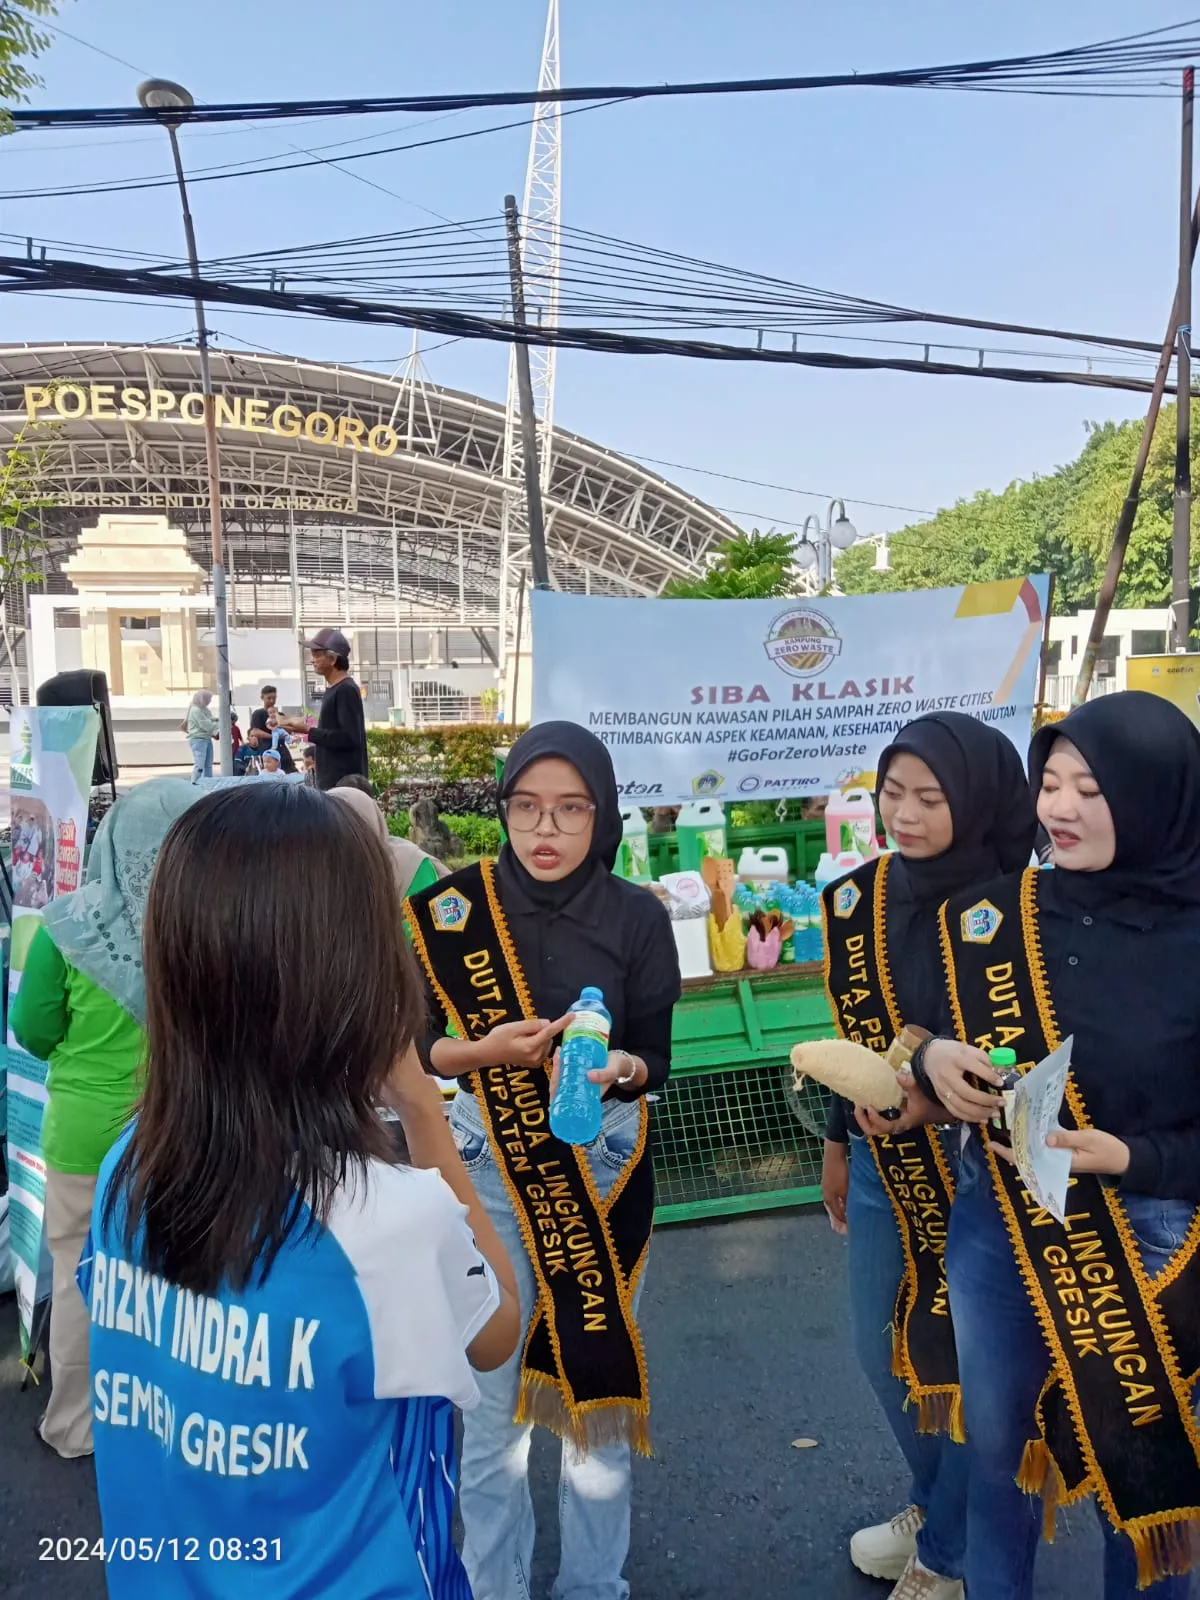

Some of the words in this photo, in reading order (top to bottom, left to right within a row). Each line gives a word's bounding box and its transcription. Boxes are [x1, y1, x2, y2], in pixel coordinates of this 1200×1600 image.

[24, 384, 398, 457] POESPONEGORO
[139, 493, 184, 508] SENI
[193, 494, 235, 509] DN
[244, 495, 358, 513] OLAHRAGA
[775, 645, 799, 655] ZERO
[801, 644, 834, 654] WASTE
[588, 711, 692, 727] MEMBANGUN
[696, 710, 768, 726] KAWASAN
[772, 707, 812, 722] PILAH
[815, 704, 874, 721] SAMPAH
[876, 700, 912, 717] ZERO
[915, 695, 958, 713] WASTE
[959, 691, 994, 708] CITIES
[690, 684, 770, 706] SIBA
[792, 675, 915, 701] KLASIK
[705, 730, 746, 744] ASPEK
[750, 727, 829, 743] KEAMANAN,
[832, 719, 902, 738] KESEHATAN
[727, 742, 867, 764] #GoForZeroWaste
[763, 777, 821, 788] PATTIRO
[845, 933, 872, 1005] DUTA
[463, 949, 508, 1025] DUTA
[506, 1063, 551, 1148] MUDA
[536, 1160, 608, 1332] LINGKUNGAN
[525, 1182, 570, 1277] GRESIK
[984, 960, 1026, 1046] DUTA
[1063, 1211, 1163, 1427] LINGKUNGAN
[91, 1250, 169, 1348] RIZKY
[170, 1282, 271, 1388] INDRA
[286, 1316, 321, 1392] K
[1042, 1245, 1104, 1358] GRESIK
[94, 1369, 176, 1456] SEMEN
[180, 1411, 310, 1477] GRESIK
